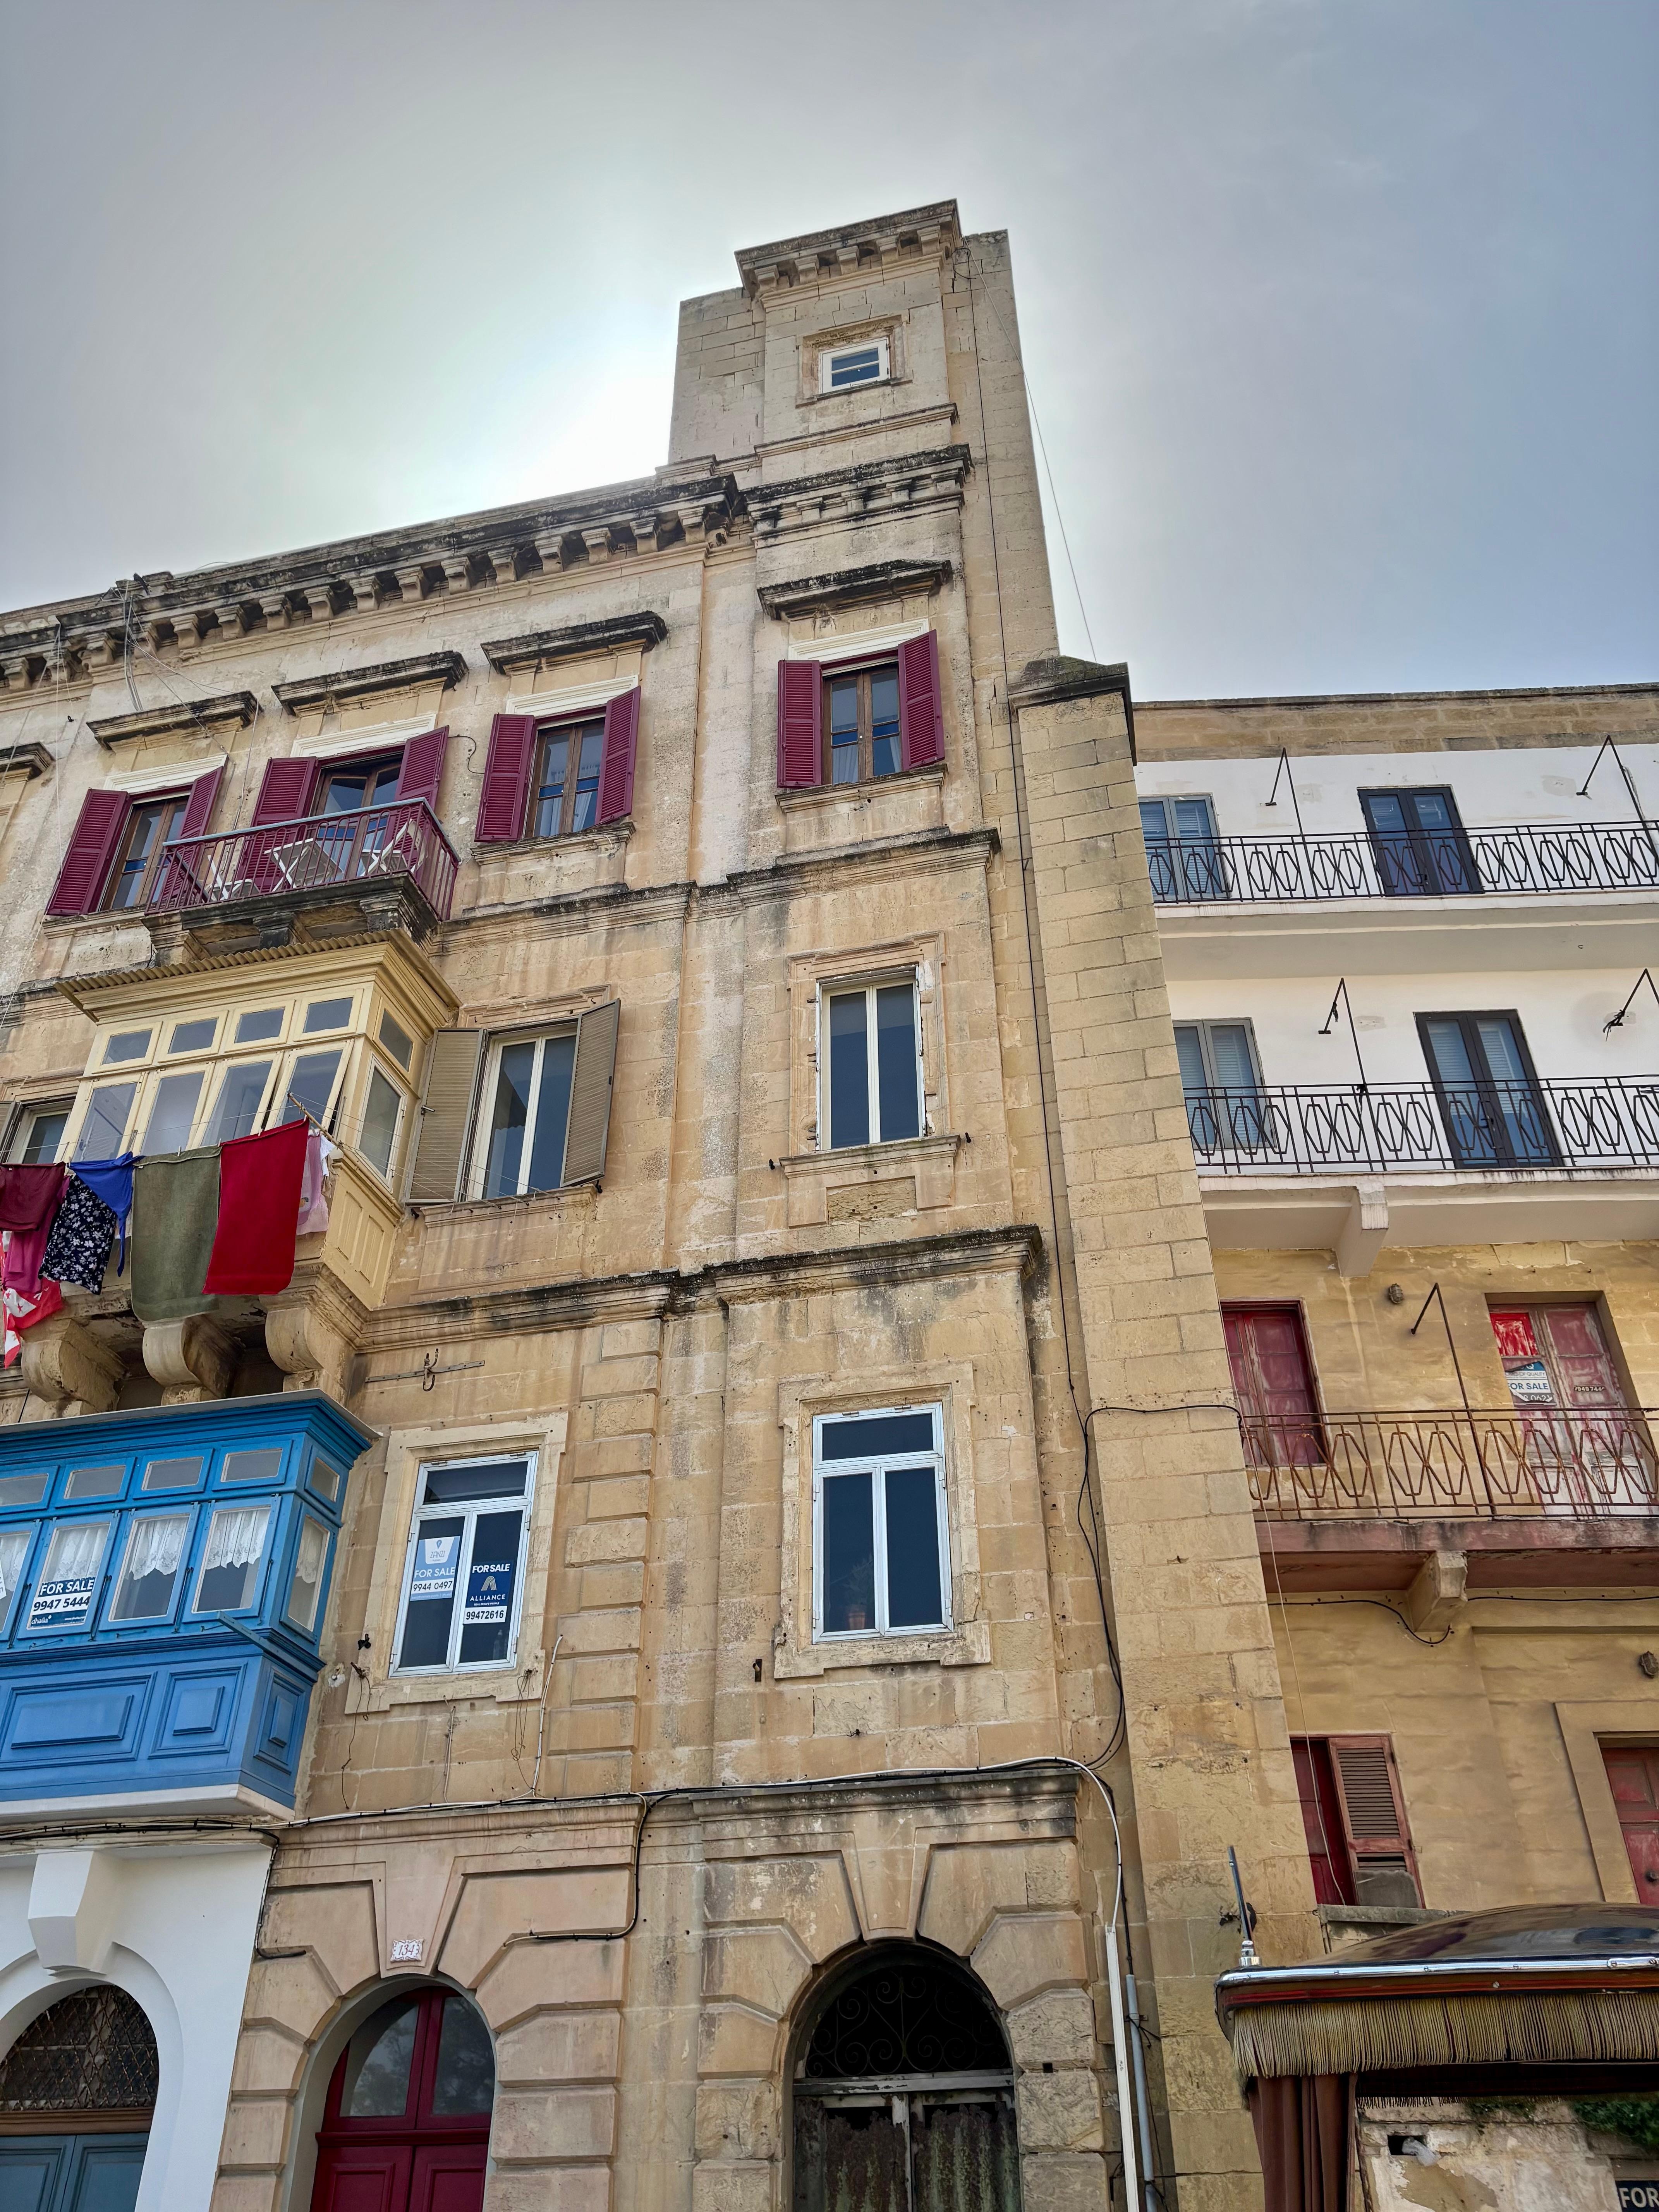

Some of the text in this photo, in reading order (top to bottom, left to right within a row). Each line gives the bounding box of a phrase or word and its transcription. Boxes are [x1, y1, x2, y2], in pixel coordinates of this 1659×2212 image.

[414, 1567, 455, 1578] FOR SALE
[472, 1564, 510, 1573] FOR SALE
[40, 1580, 94, 1595] FOR SALE
[414, 1581, 453, 1592] 9944 0497
[33, 1596, 91, 1611] 9947 5444
[466, 1610, 504, 1620] 99472616
[398, 1944, 415, 1955] 134
[1619, 2187, 1659, 2208] FOR
